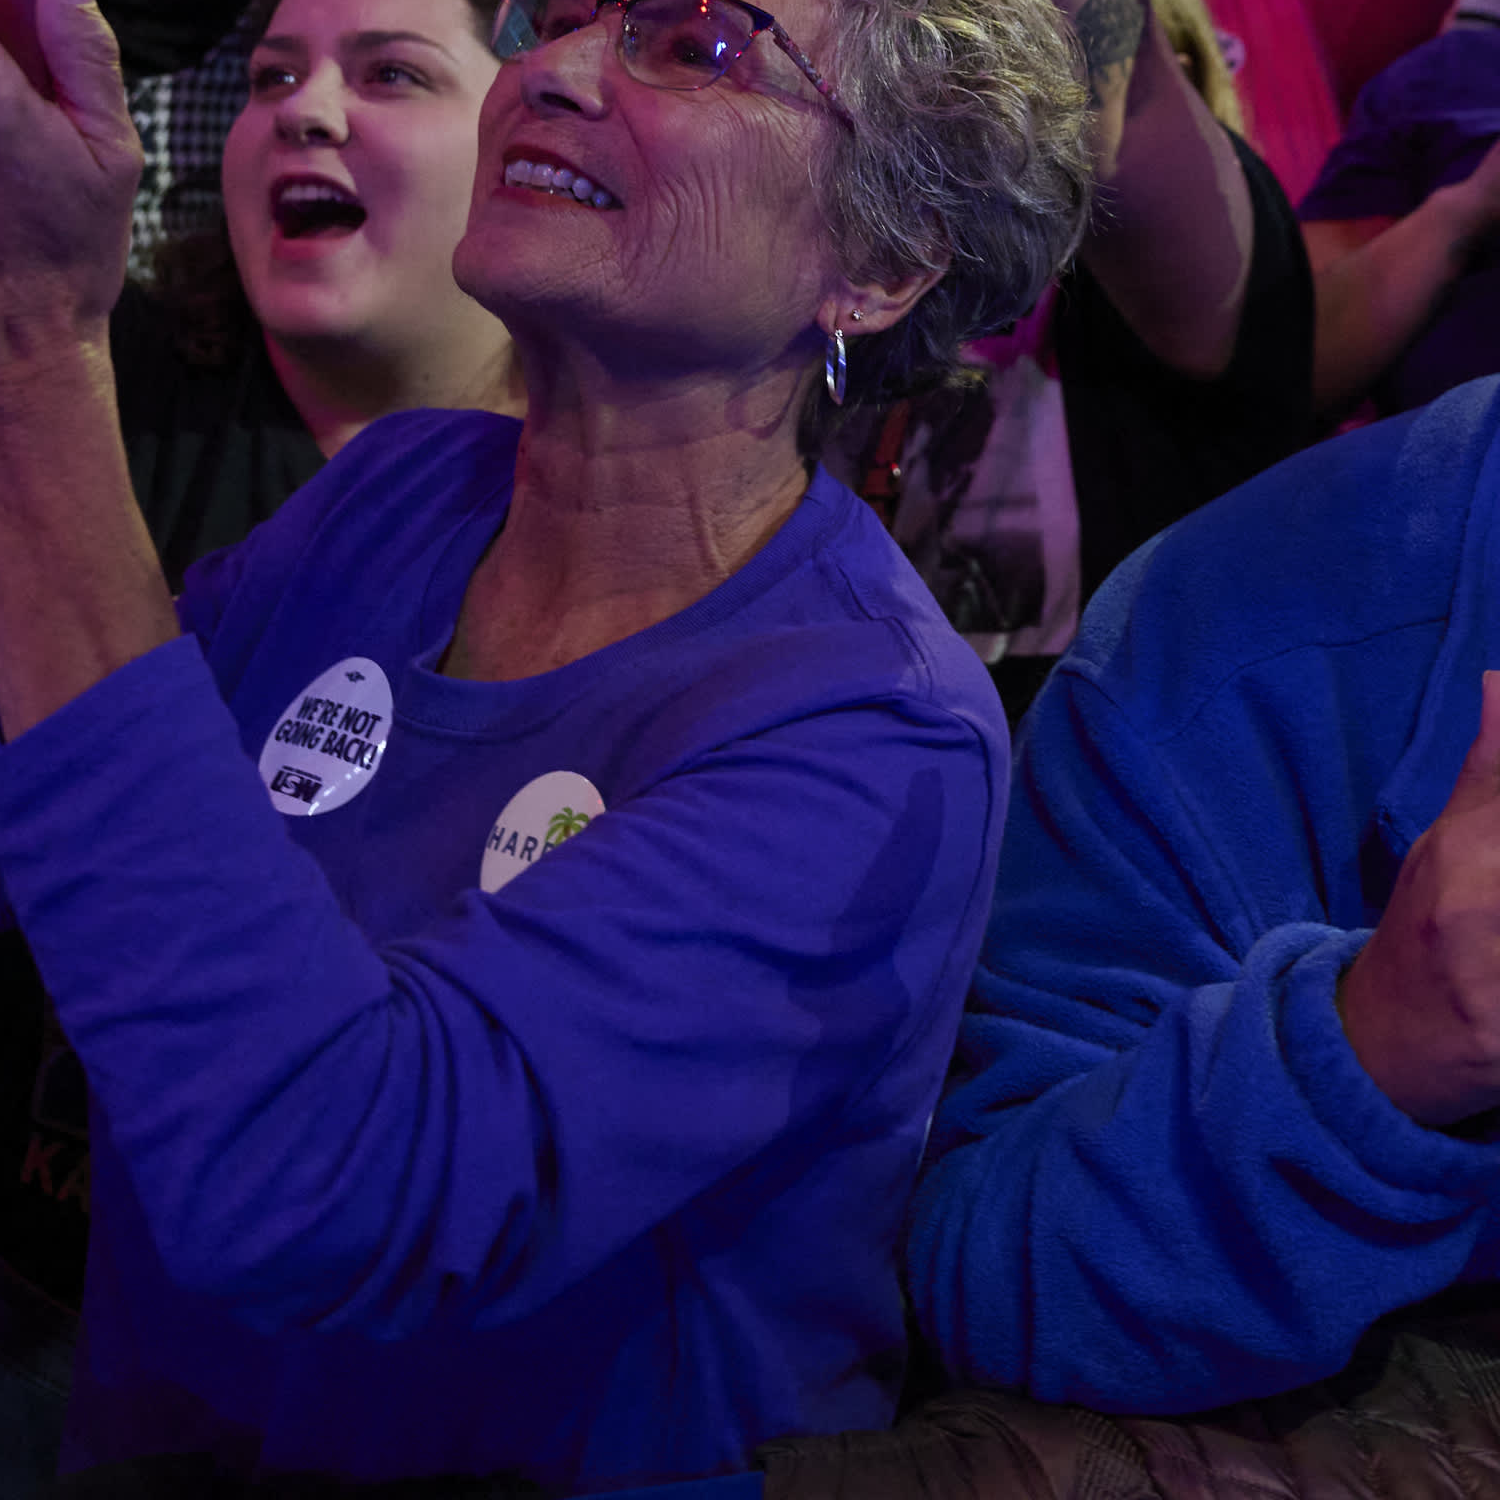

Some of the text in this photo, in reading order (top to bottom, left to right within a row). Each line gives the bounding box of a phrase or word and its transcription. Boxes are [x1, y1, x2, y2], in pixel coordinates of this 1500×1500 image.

[297, 696, 383, 739] WE'RE NOT
[275, 719, 379, 770] GOING BACK!
